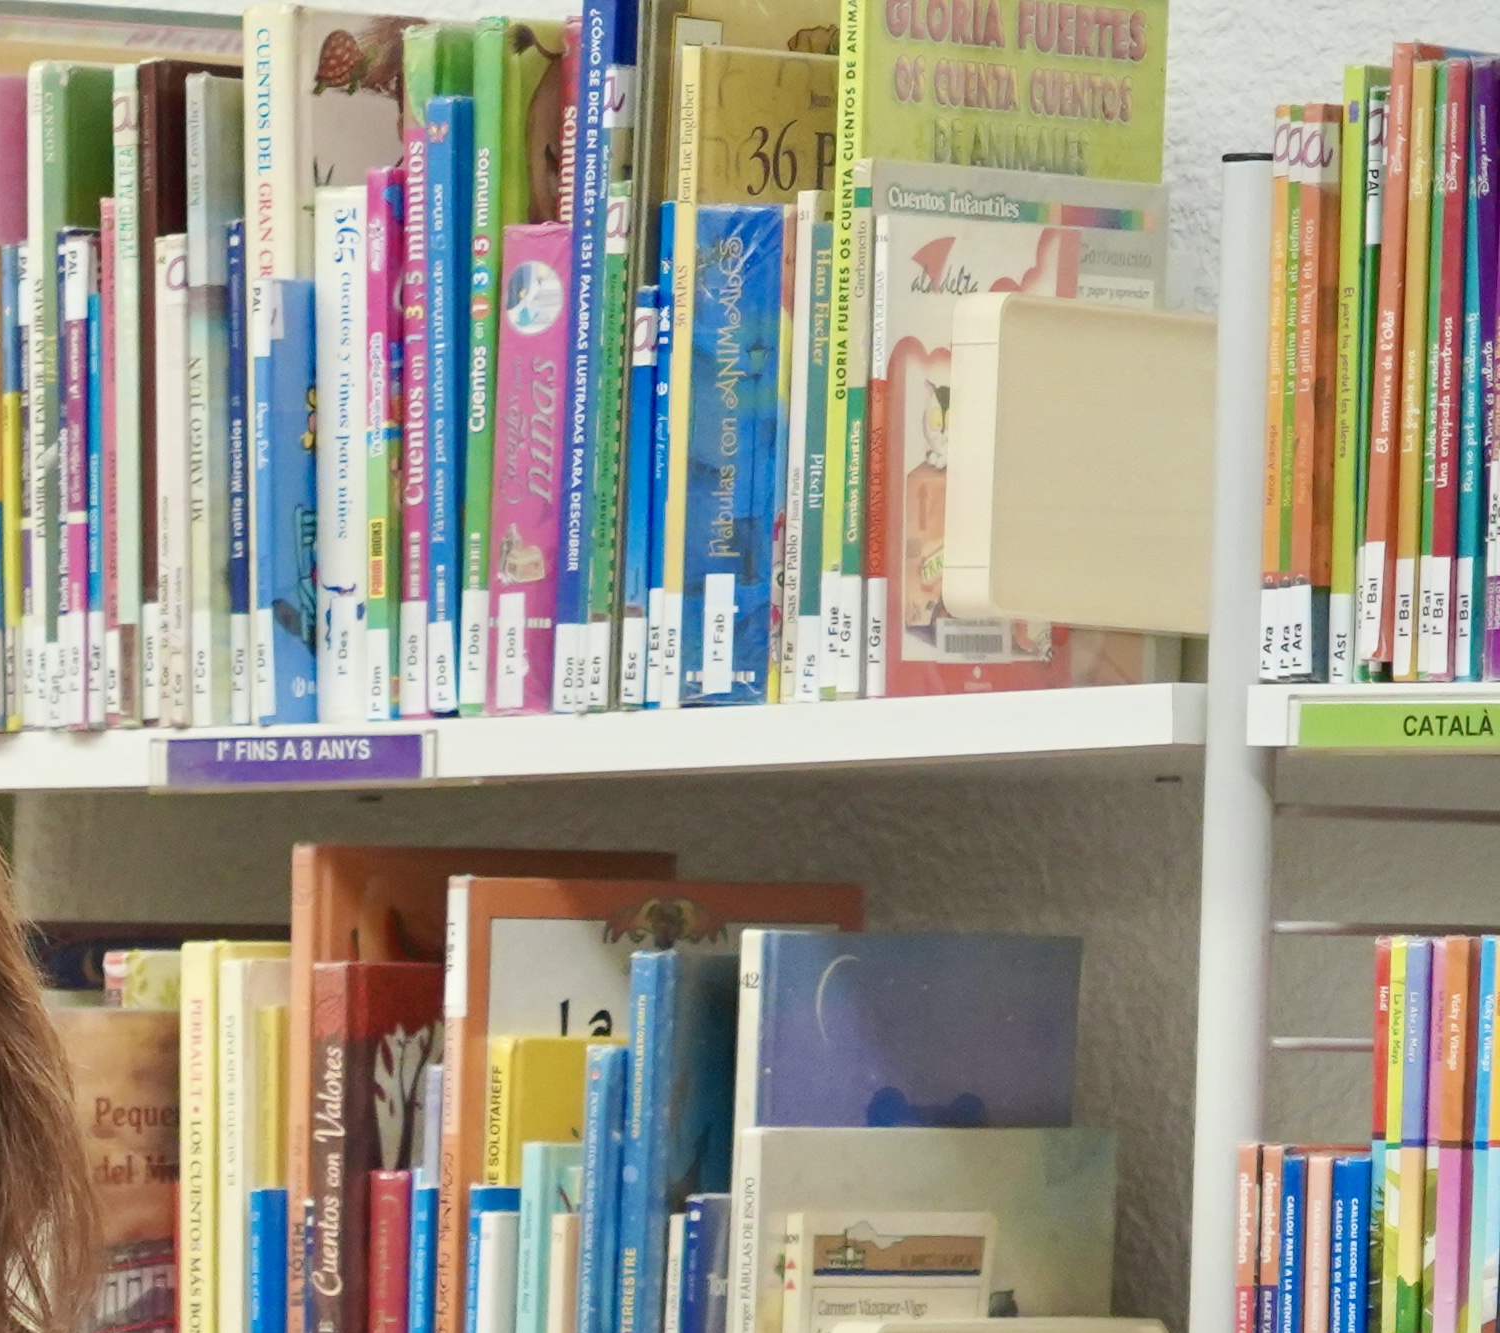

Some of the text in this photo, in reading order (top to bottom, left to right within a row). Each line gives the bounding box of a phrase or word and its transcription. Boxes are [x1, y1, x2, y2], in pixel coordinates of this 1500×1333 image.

[884, 0, 1148, 62] GLORIA FUERTES
[894, 54, 1133, 124] OS CUENTA CUENTOS
[45, 92, 54, 163] CANNON
[256, 28, 273, 243] CUENTOS DEL GRAN
[679, 83, 695, 205] Jean-Luc Englebert
[747, 119, 798, 197] 36
[971, 119, 1090, 177] ANIMALES
[559, 105, 578, 231] minutos
[888, 186, 1021, 219] Cuentos Infantiles
[1368, 169, 1380, 198] PAL
[334, 207, 360, 346] 365 cuentos
[836, 83, 857, 400] GLORIA FUERTES CUENTA CUENTOS
[854, 220, 867, 299] Garbancito
[404, 140, 424, 505] Cuentos minutos
[470, 148, 490, 433] Cuentos minutos
[568, 8, 603, 573] ¿CÓMO DICE INGLÉS? 1351 PALABRAS ILUSTRADAS PARA DESCUBRIR
[675, 264, 688, 310] PAPAS
[1301, 220, 1314, 373] gallina Mina micos
[1286, 330, 1299, 376] gallina
[1340, 354, 1352, 393] perdut
[1442, 317, 1454, 391] monstruosa
[188, 357, 205, 486] AMIGO JUAN
[1380, 375, 1392, 432] somriure
[848, 420, 861, 481] Infantiles
[236, 738, 371, 761] FINS A 8 ANYS
[1403, 709, 1495, 738] CATALÀ
[1378, 986, 1390, 1011] Heidi
[189, 999, 205, 1297] PERRAULT CUENTOS MÁS
[488, 1064, 503, 1173] SOLOTAREFF
[311, 1046, 346, 1296] Cuentos con Valores
[1237, 1172, 1252, 1264] nickelodeon
[1261, 1172, 1278, 1264] nickelodeon
[1285, 1196, 1295, 1235] CAILLOU
[1349, 1198, 1359, 1238] CAILLOU
[1348, 1241, 1358, 1279] RECOGE
[817, 1299, 858, 1316] Carmen
